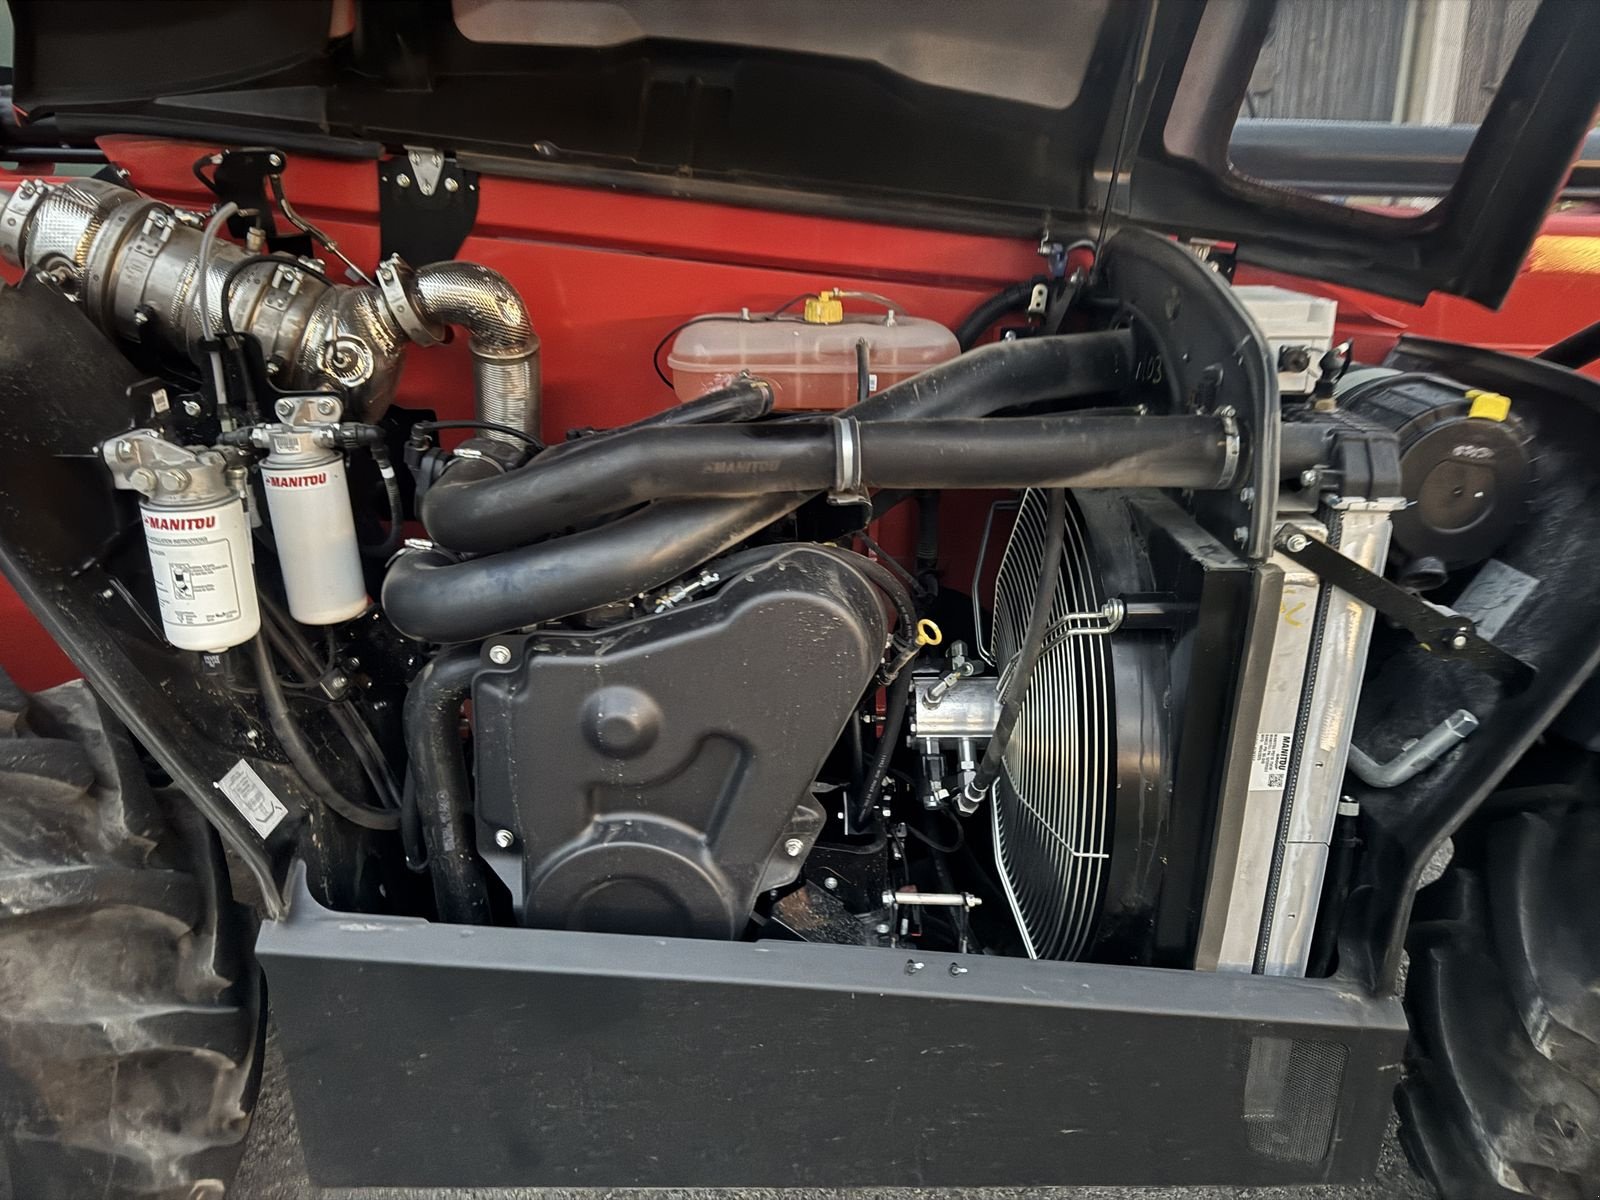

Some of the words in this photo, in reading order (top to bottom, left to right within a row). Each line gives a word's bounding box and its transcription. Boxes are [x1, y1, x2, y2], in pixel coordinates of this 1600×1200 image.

[269, 472, 327, 488] MANITOU
[149, 515, 216, 531] MANITOU
[1278, 735, 1291, 771] MANITOU
